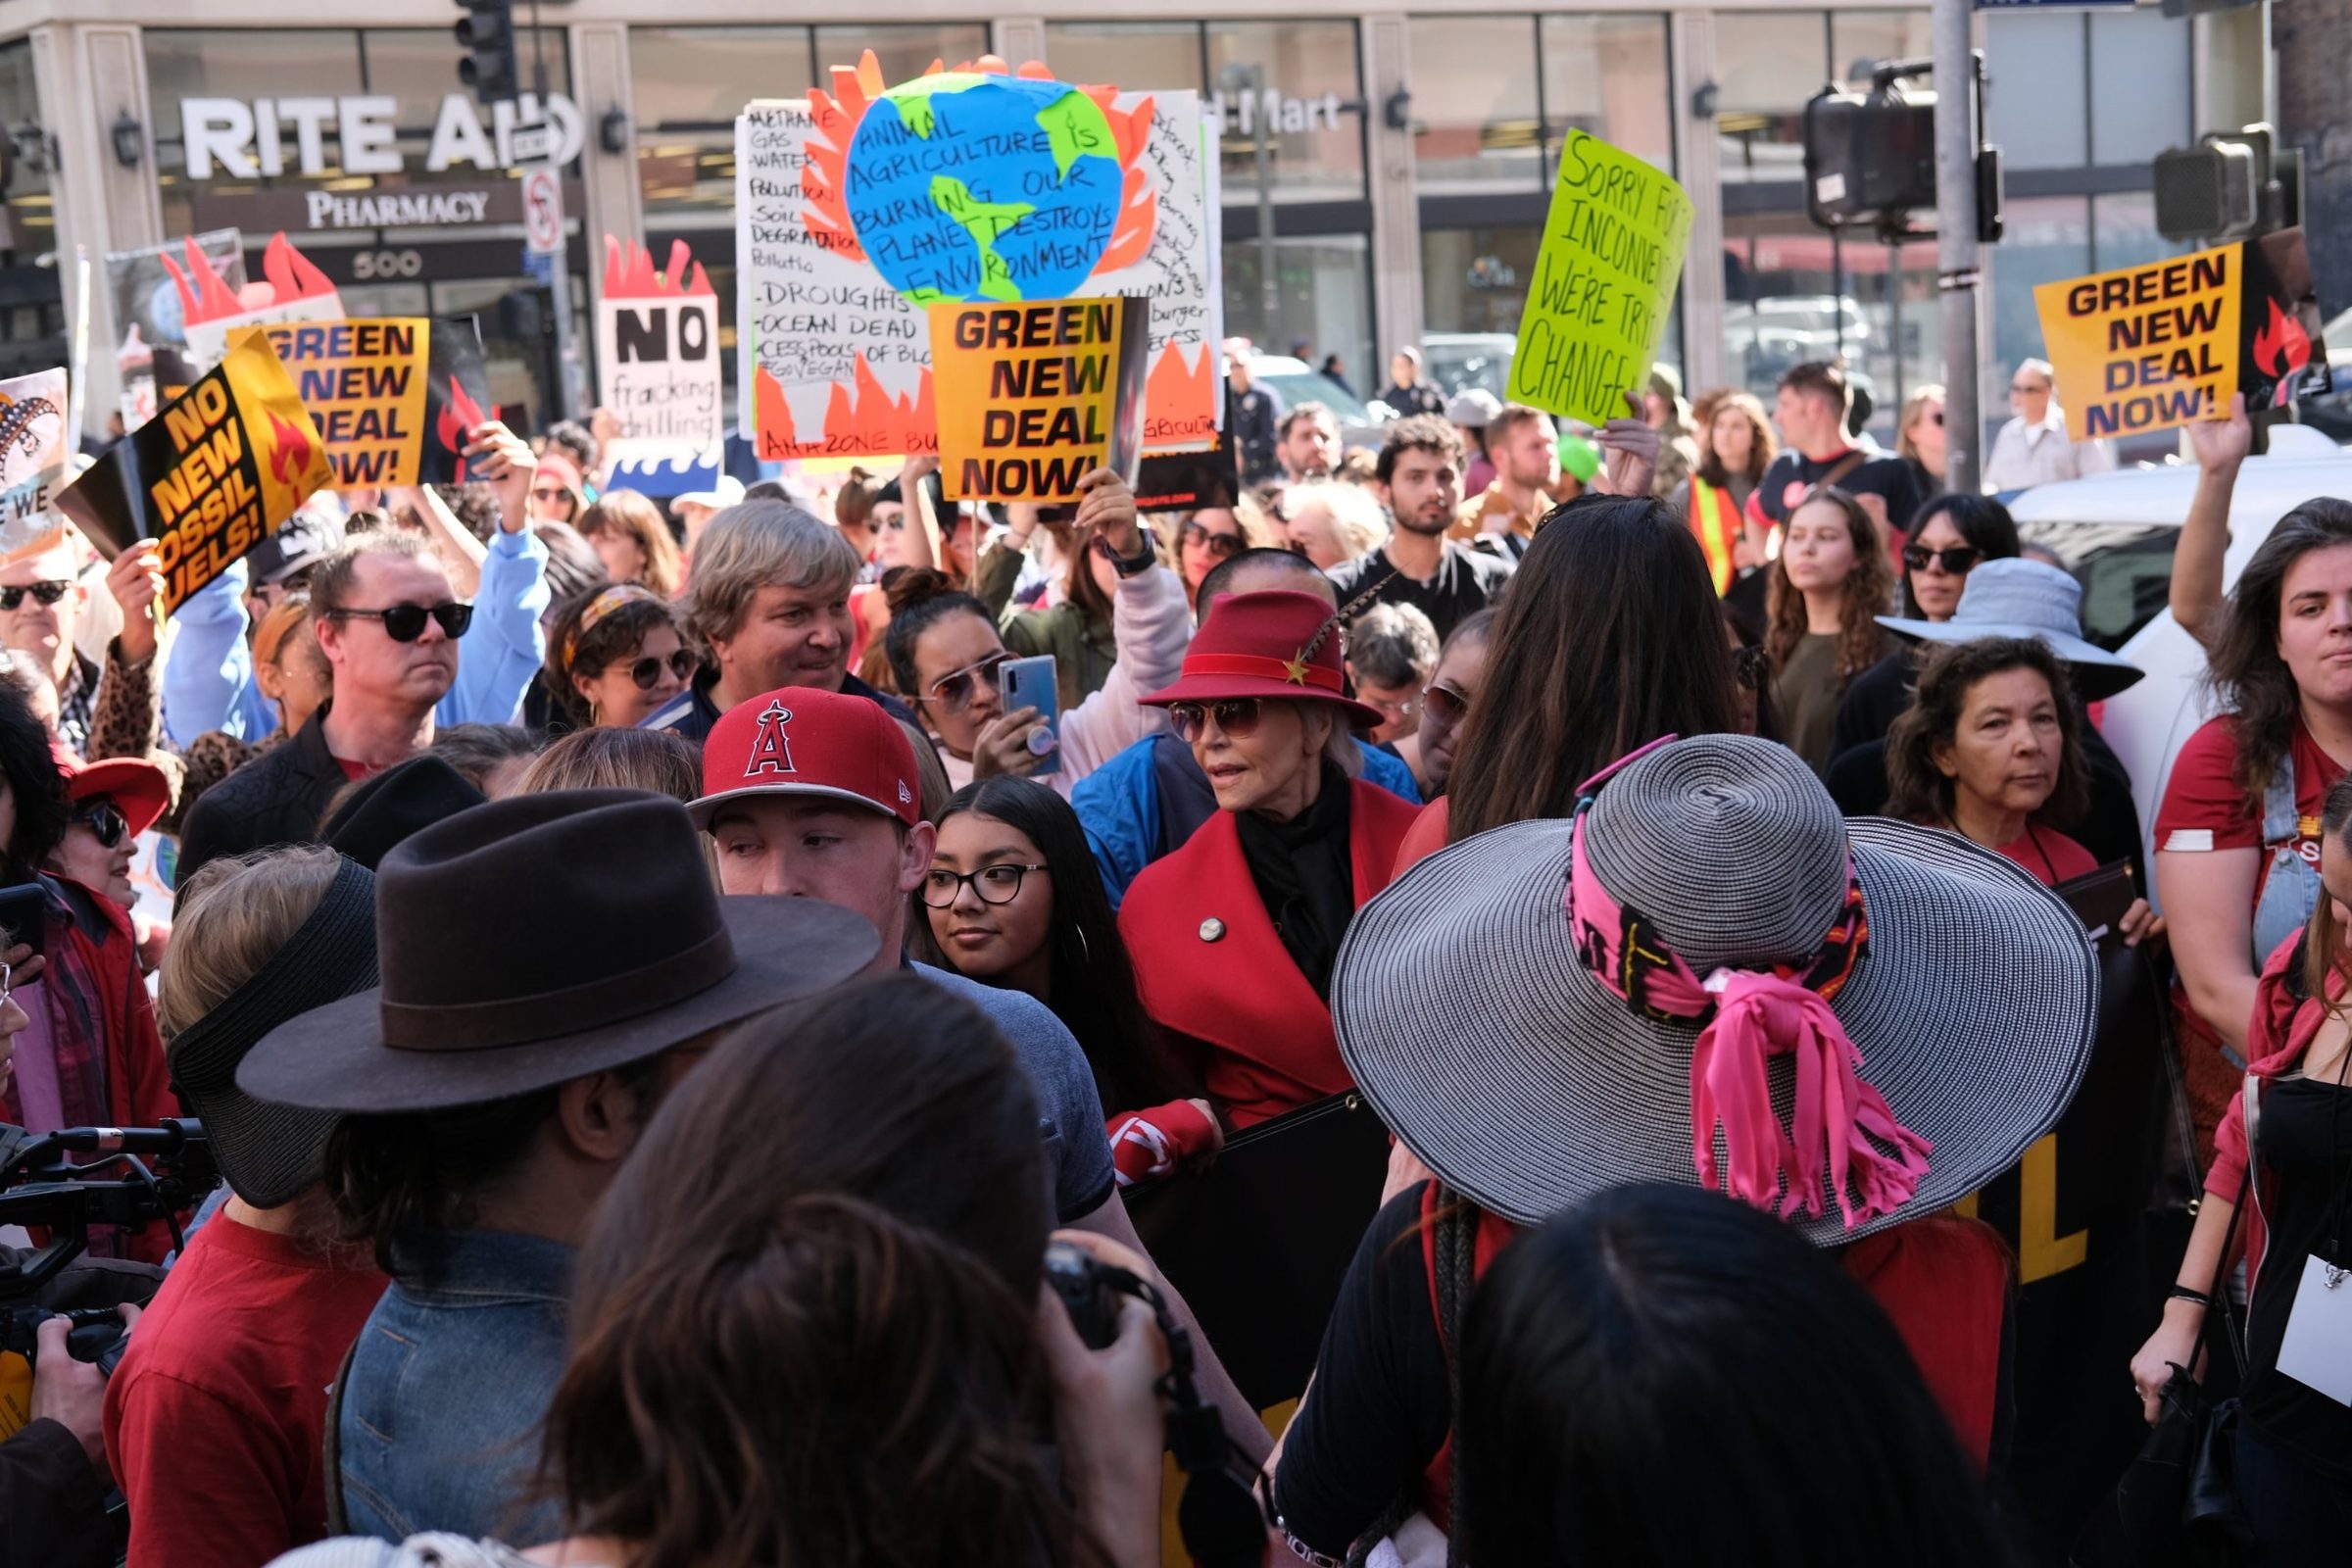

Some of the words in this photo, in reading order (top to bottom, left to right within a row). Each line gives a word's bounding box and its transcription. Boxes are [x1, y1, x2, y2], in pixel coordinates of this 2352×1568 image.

[180, 97, 404, 178] RITE
[426, 93, 586, 172] AID
[752, 131, 791, 148] GAS
[858, 110, 965, 154] ANIMAL
[851, 131, 1053, 194] AGRICULTURE
[1022, 165, 1096, 197] OUR
[1563, 135, 1647, 220] SORRY
[306, 191, 489, 228] PHARMACY
[873, 218, 980, 268] PLANET
[992, 204, 1112, 240] DESTROYS
[1560, 199, 1664, 285] INCONVE
[353, 250, 422, 278] 500
[905, 234, 1109, 300] ENVIRONMENT
[1541, 252, 1613, 327] WE'RE
[2068, 253, 2226, 318] GREEN
[267, 325, 414, 361] GREEN
[615, 306, 708, 364] NO
[849, 316, 916, 339] DEAD
[956, 304, 1113, 350] GREEN
[2109, 297, 2223, 353] NEW
[866, 346, 890, 363] OF
[990, 355, 1108, 399] NEW
[2105, 343, 2223, 394] DEAL
[300, 366, 412, 403] NEW
[613, 368, 715, 412] fracking
[164, 376, 228, 454] NO
[620, 410, 713, 454] drilling
[983, 405, 1106, 448] DEAL
[2086, 385, 2216, 437] NOW!
[151, 416, 242, 525] NEW
[14, 484, 49, 520] WE
[159, 466, 257, 576] OSSIL
[163, 503, 261, 613] UELS!
[743, 699, 798, 777] A
